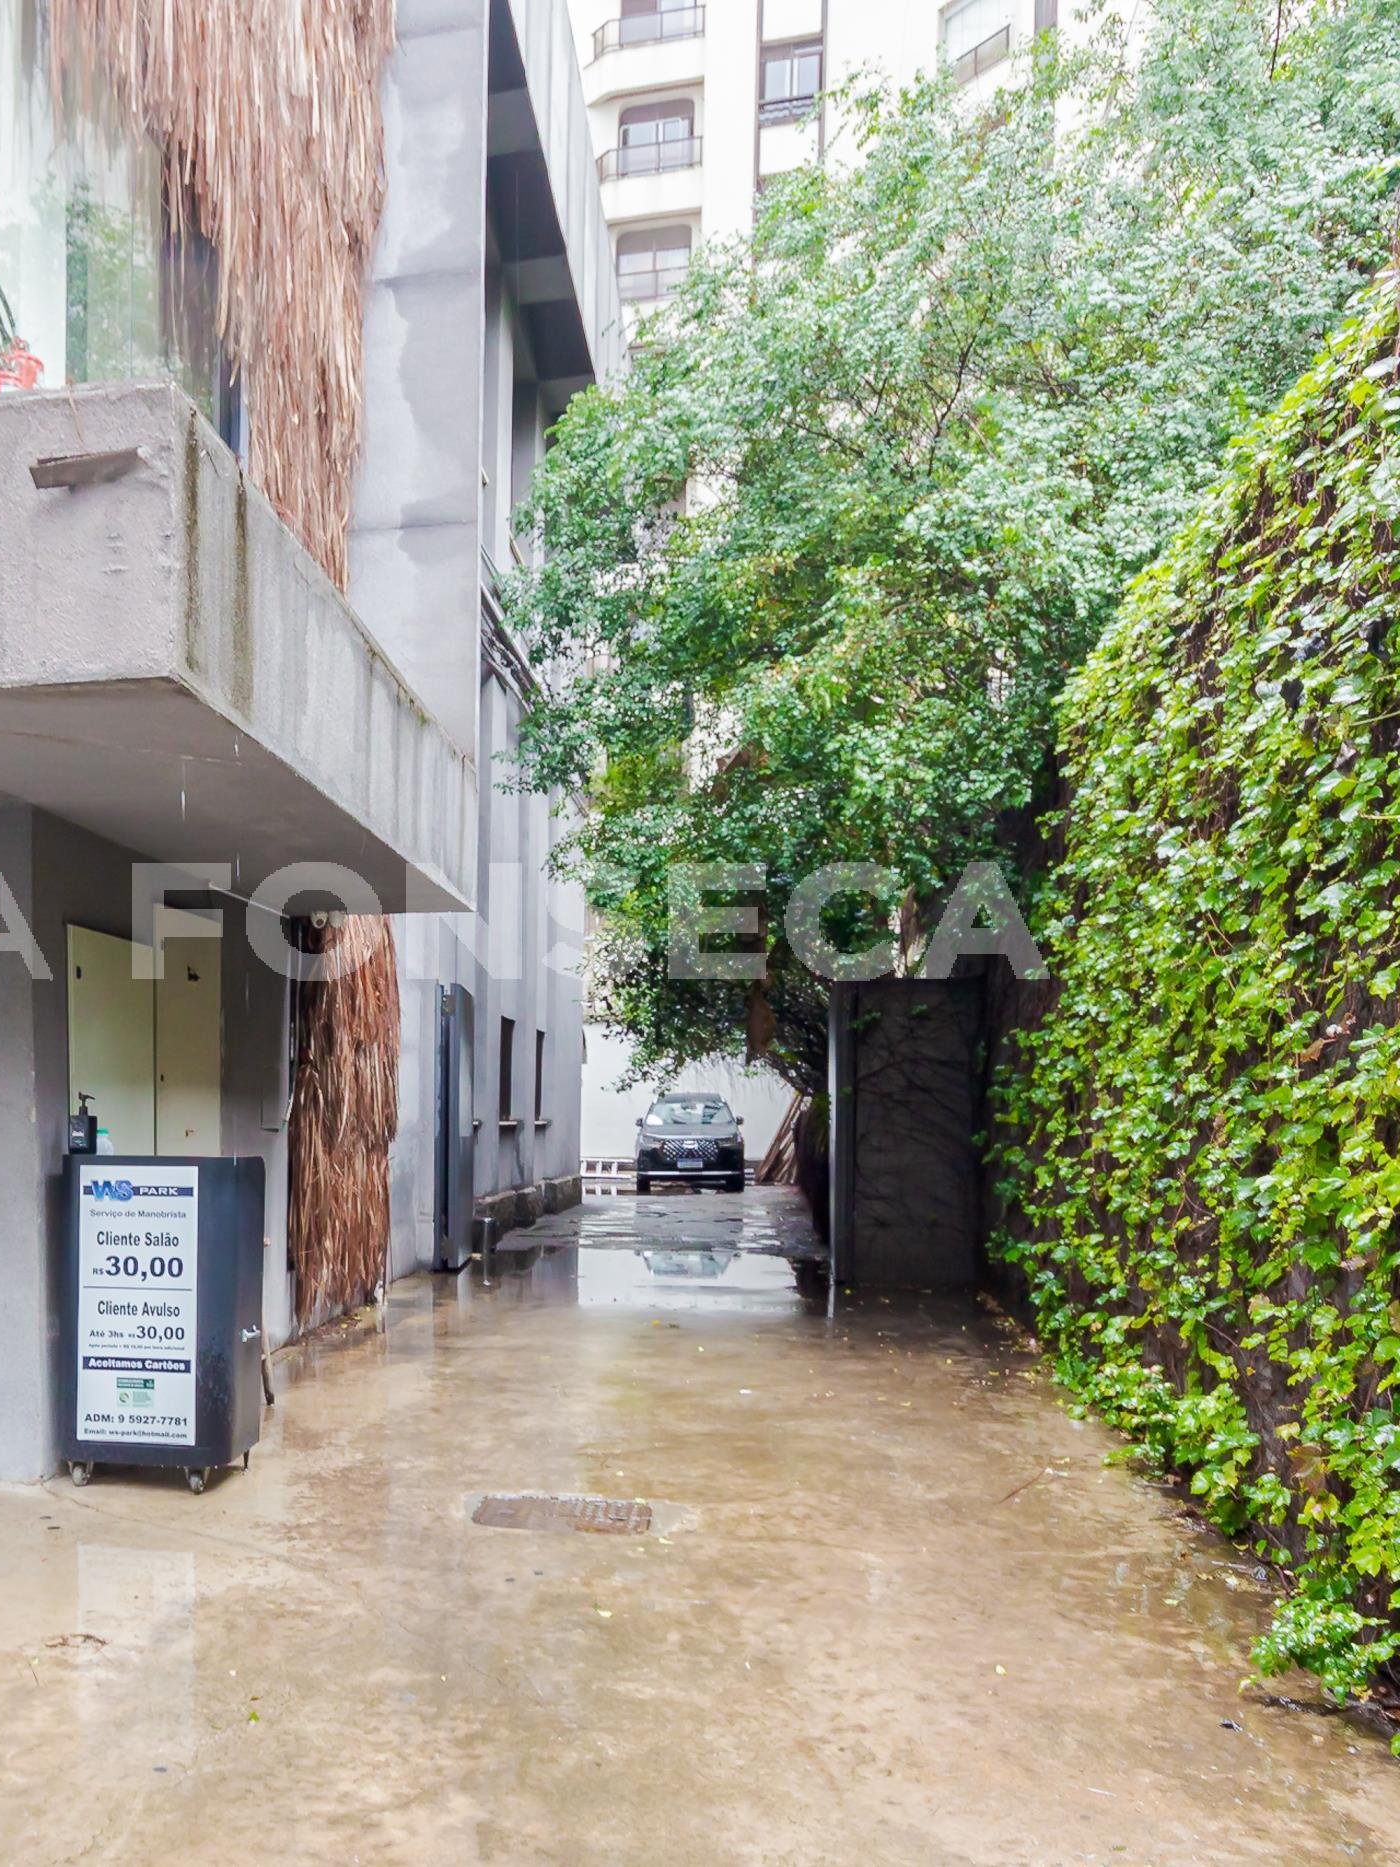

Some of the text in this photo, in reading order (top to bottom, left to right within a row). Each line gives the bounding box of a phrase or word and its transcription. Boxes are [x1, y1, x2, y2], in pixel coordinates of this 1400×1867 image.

[90, 1179, 179, 1201] WS PARK
[89, 1209, 186, 1219] Serviço de Manobrista
[96, 1231, 180, 1247] Cliente Salão
[97, 1300, 181, 1317] Cliente Avulso
[89, 1329, 105, 1338] Até
[108, 1330, 124, 1338] 3hs
[88, 1358, 186, 1371] Aceitamos Cartões
[84, 1413, 188, 1426] ADM: 9 5927-7781
